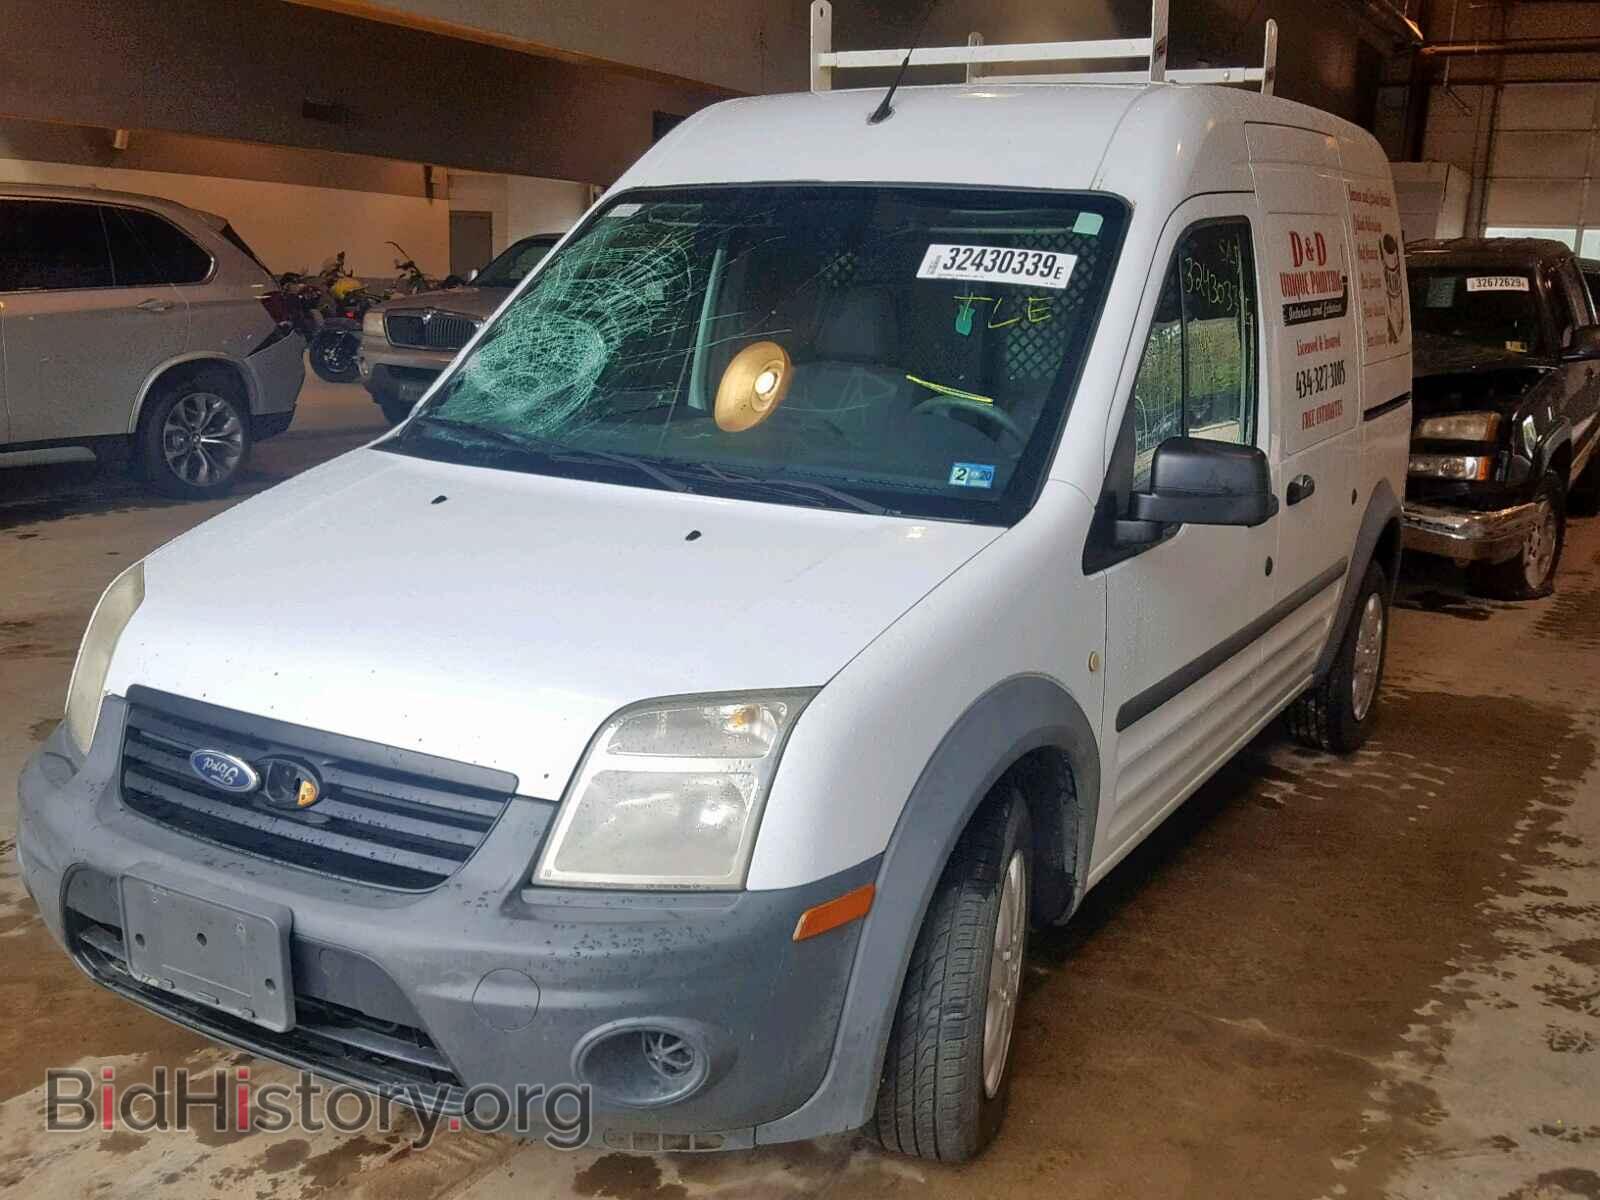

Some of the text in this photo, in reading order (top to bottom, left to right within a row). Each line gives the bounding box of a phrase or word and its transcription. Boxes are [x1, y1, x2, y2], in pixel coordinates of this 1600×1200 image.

[1280, 271, 1309, 300] UNIQUE
[955, 468, 967, 481] 2
[202, 757, 239, 785] Ford
